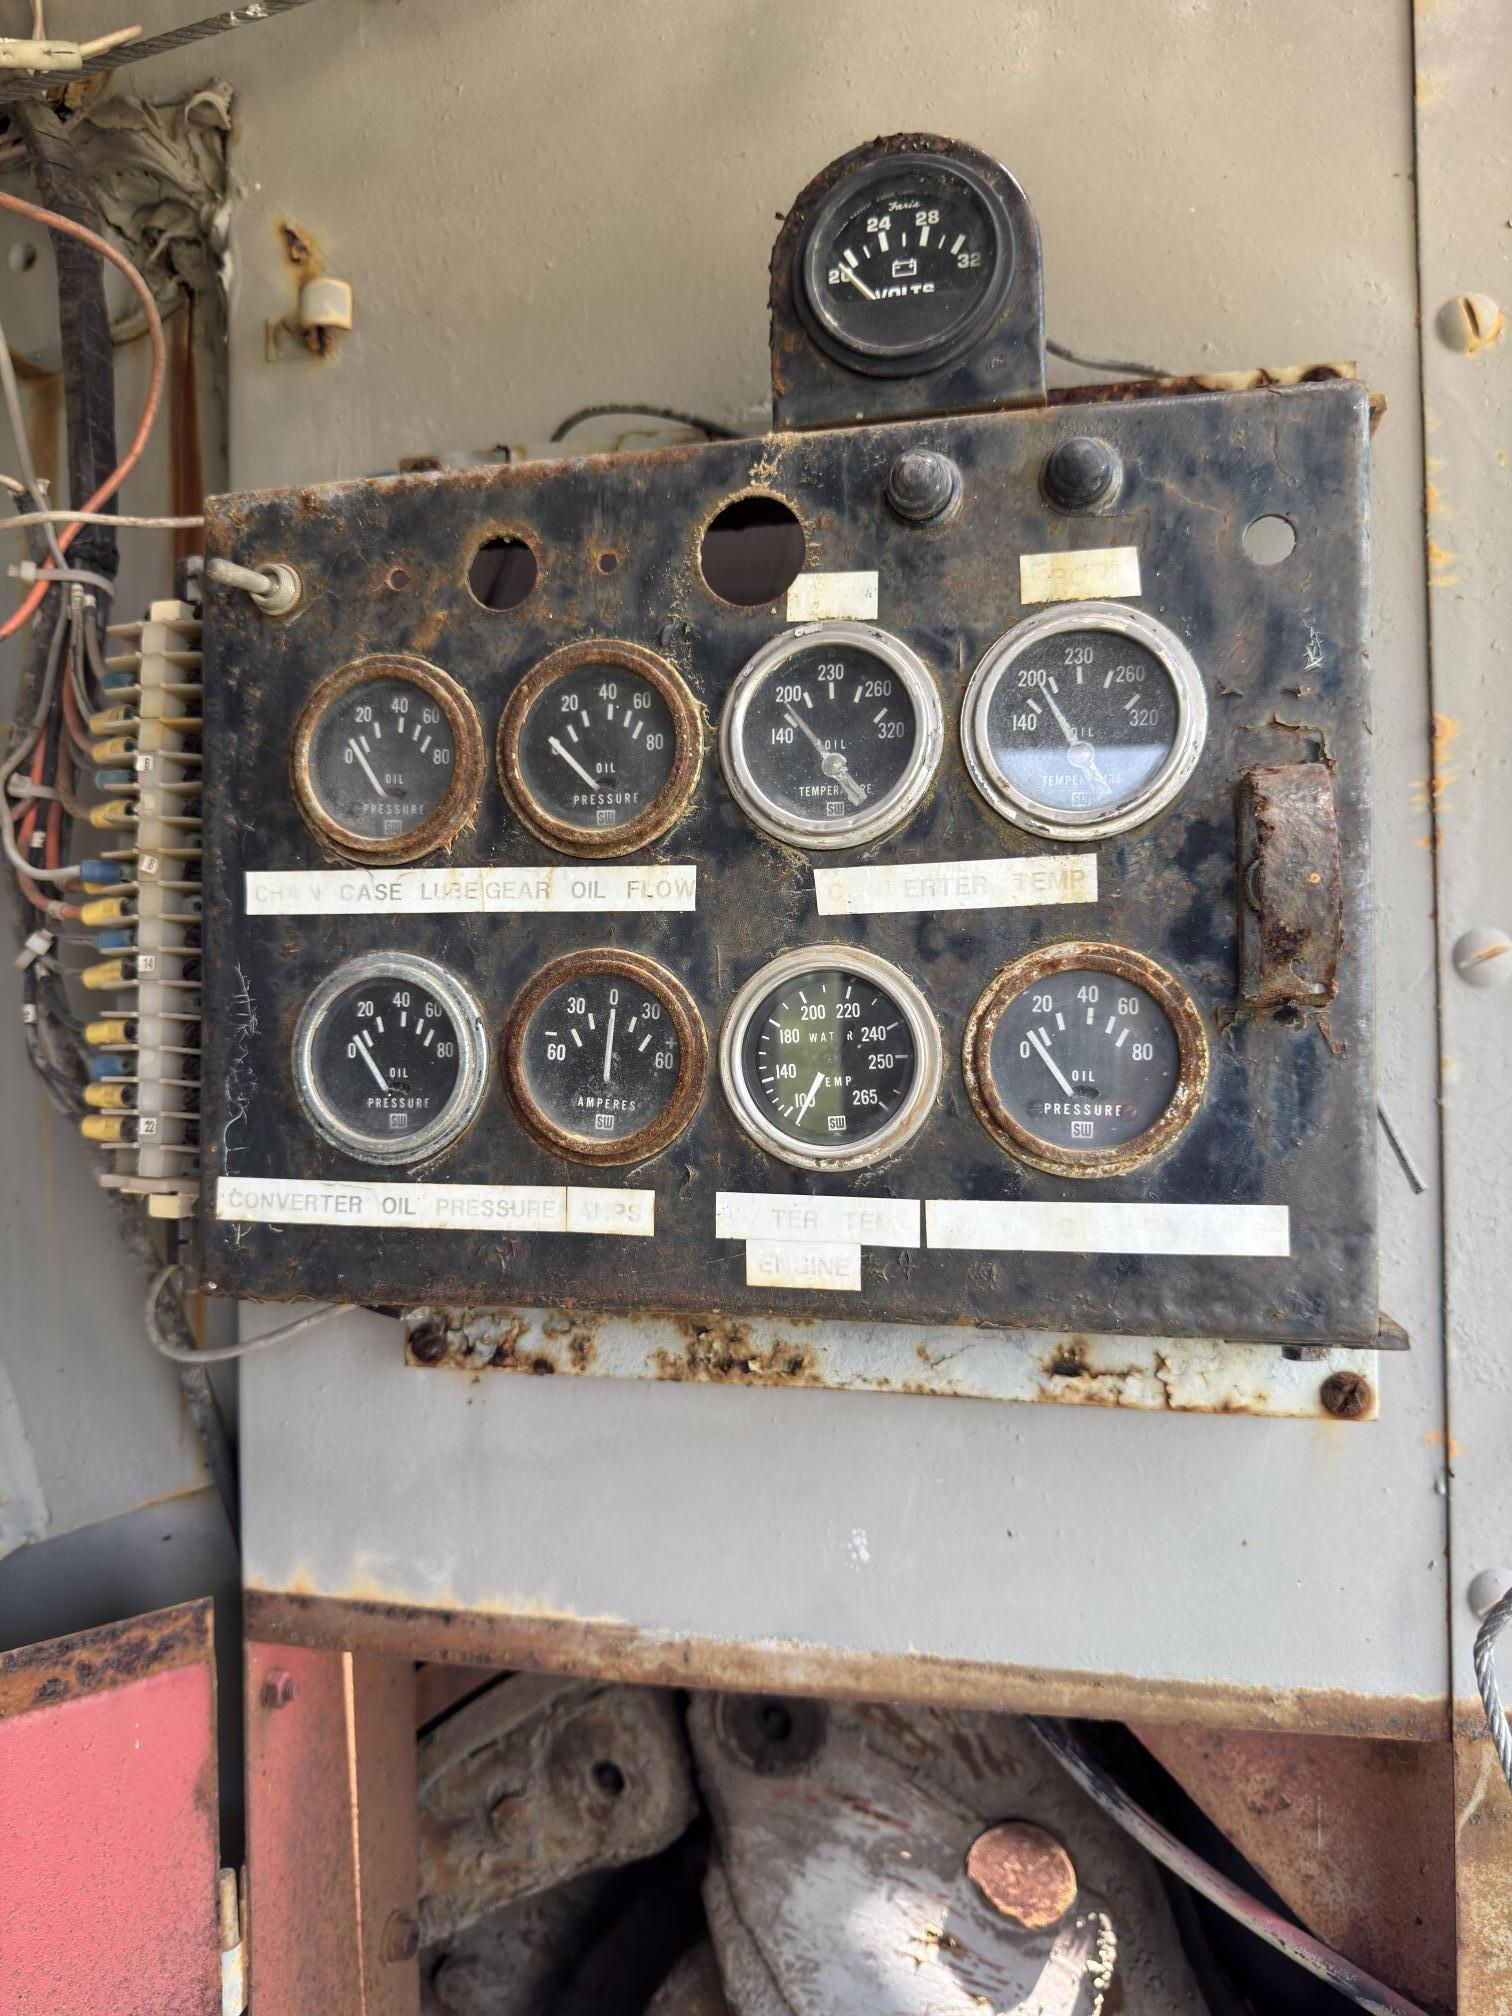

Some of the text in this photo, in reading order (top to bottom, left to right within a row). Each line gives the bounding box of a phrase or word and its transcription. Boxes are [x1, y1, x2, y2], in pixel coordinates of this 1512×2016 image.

[889, 200, 921, 212] Faria
[867, 216, 891, 232] 24
[915, 210, 939, 226] 28
[957, 253, 981, 268] 32
[828, 268, 852, 284] 20
[1064, 648, 1093, 665] 230
[818, 664, 844, 680] 230
[1018, 670, 1045, 687] 200
[1116, 666, 1144, 683] 260
[599, 683, 617, 700] 40
[776, 686, 801, 702] 200
[865, 681, 891, 697] 260
[391, 697, 408, 713] 40
[561, 695, 578, 711] 20
[633, 693, 651, 709] 60
[355, 706, 371, 722] 20
[423, 708, 439, 724] 60
[1129, 709, 1158, 727] 320
[1013, 714, 1037, 731] 140
[771, 728, 793, 744] 140
[877, 723, 904, 739] 320
[1072, 727, 1094, 737] OIL
[646, 734, 663, 750] 80
[825, 740, 846, 750] OIL
[345, 749, 353, 764] 0
[433, 749, 449, 764] 80
[596, 763, 615, 773] OIL
[386, 774, 403, 785] OIL
[573, 793, 639, 804] PRESSURE
[363, 804, 425, 815] PRESSURE
[1013, 869, 1085, 893] TEMP
[340, 883, 402, 901] CASE
[421, 881, 479, 901] LUBE
[485, 879, 696, 900] GEAR OIL FLOW
[144, 957, 154, 970] 14
[393, 992, 410, 1008] 40
[610, 989, 618, 1005] 0
[1077, 986, 1098, 1003] 40
[357, 1001, 373, 1017] 20
[425, 1001, 442, 1017] 60
[567, 997, 585, 1014] 30
[642, 1003, 660, 1019] 30
[836, 1003, 860, 1019] 220
[1032, 995, 1052, 1012] 20
[1118, 998, 1139, 1015] 60
[801, 1004, 825, 1021] 200
[780, 1029, 800, 1044] 180
[808, 1031, 853, 1043] WATR
[861, 1026, 887, 1042] 240
[348, 1043, 356, 1059] 0
[437, 1042, 453, 1058] 80
[547, 1044, 566, 1061] 60
[1020, 1041, 1030, 1058] 0
[1132, 1043, 1153, 1060] 80
[655, 1052, 673, 1069] 60
[868, 1054, 894, 1070] 250
[389, 1067, 408, 1078] OIL
[776, 1063, 797, 1079] 140
[1072, 1070, 1095, 1082] OIL
[819, 1076, 852, 1087] EMP
[367, 1097, 430, 1109] PRESSURE
[577, 1096, 636, 1111] AMPERES
[795, 1093, 815, 1108] 100
[852, 1089, 878, 1105] 265
[1044, 1103, 1122, 1116] PRESSURE
[144, 1120, 155, 1133] 22
[595, 1114, 614, 1130] SW
[828, 1115, 846, 1131] SW
[1071, 1121, 1093, 1138] SW
[229, 1191, 556, 1219] CONVERTER OIL PRESSURE
[759, 1255, 850, 1276] ENGINE
